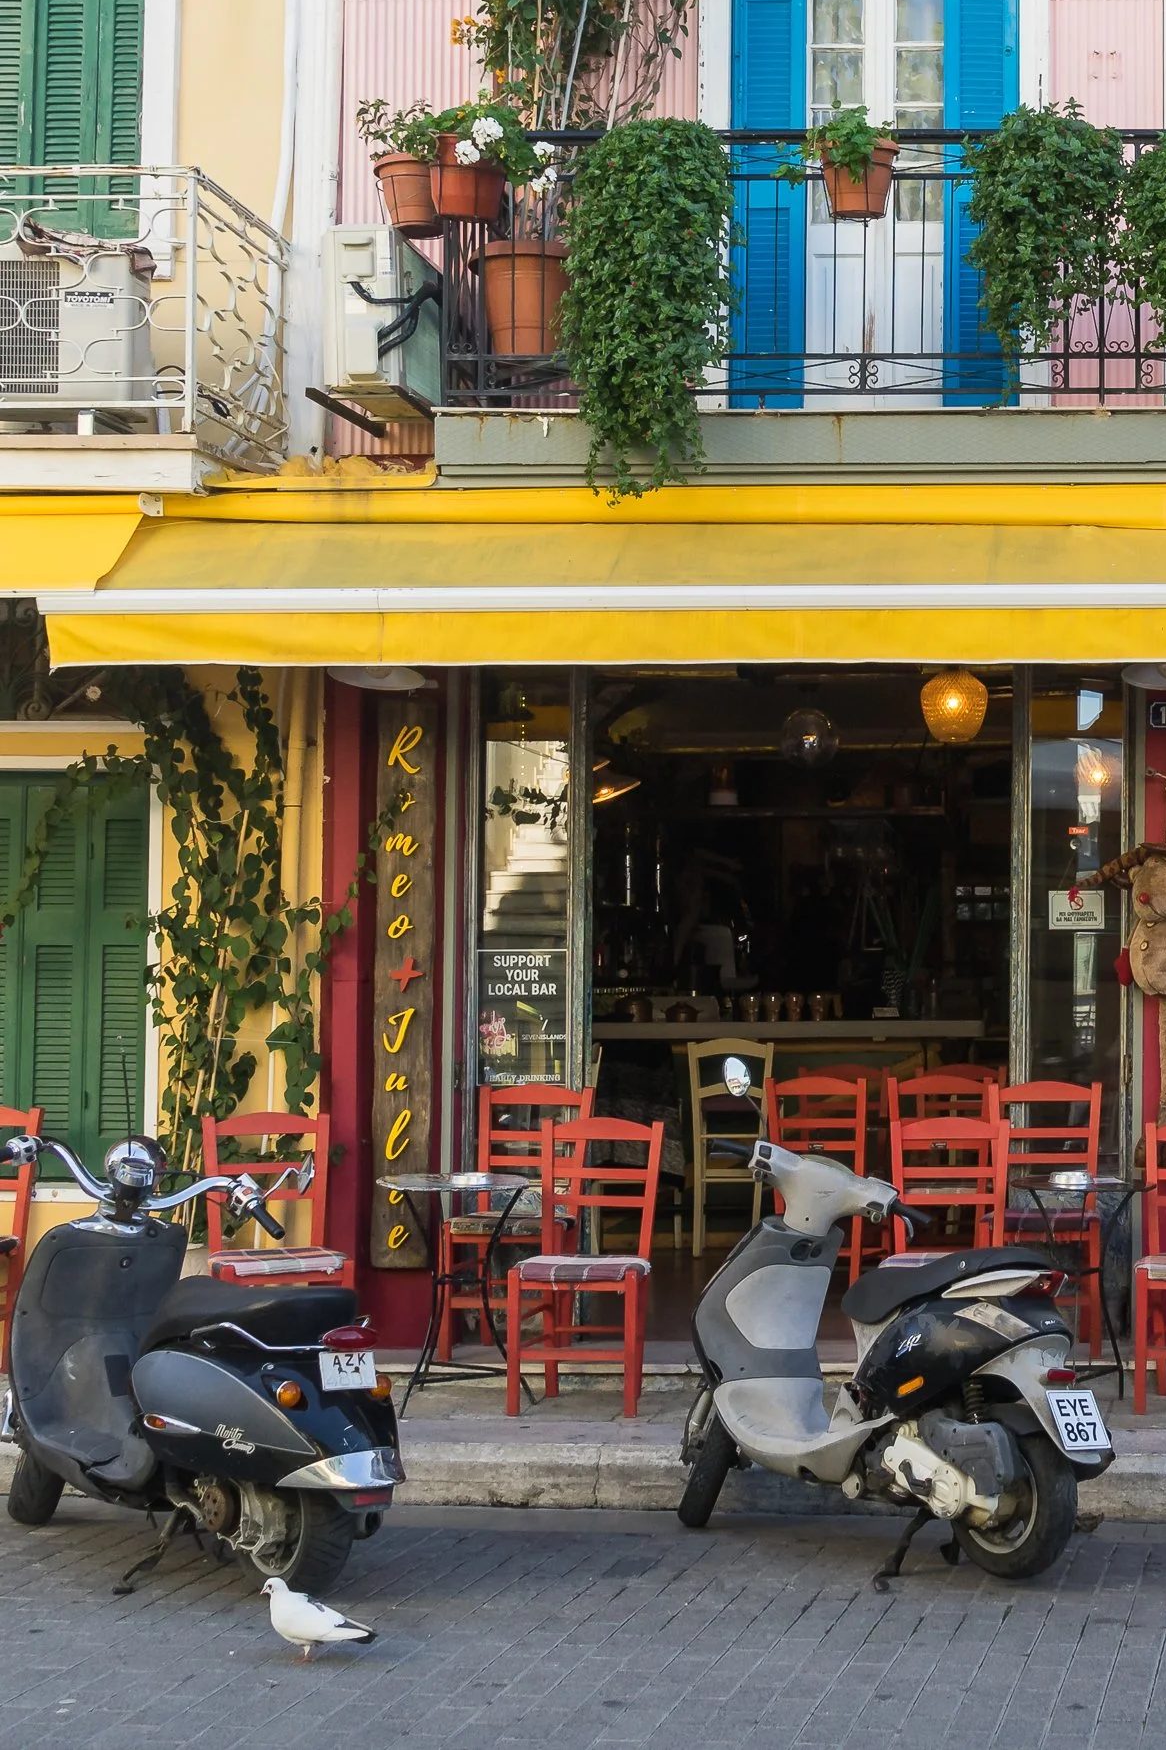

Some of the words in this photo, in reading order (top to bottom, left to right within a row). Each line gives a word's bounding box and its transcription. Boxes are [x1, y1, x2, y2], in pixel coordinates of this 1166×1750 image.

[493, 954, 552, 968] SUPPORT
[505, 969, 539, 981] YOUR
[488, 984, 529, 996] LOCAL
[531, 984, 557, 996] BAR
[519, 1074, 560, 1082] DRINKING
[332, 1353, 366, 1367] AZK
[1055, 1398, 1093, 1417] EYE
[1064, 1421, 1097, 1443] 867
